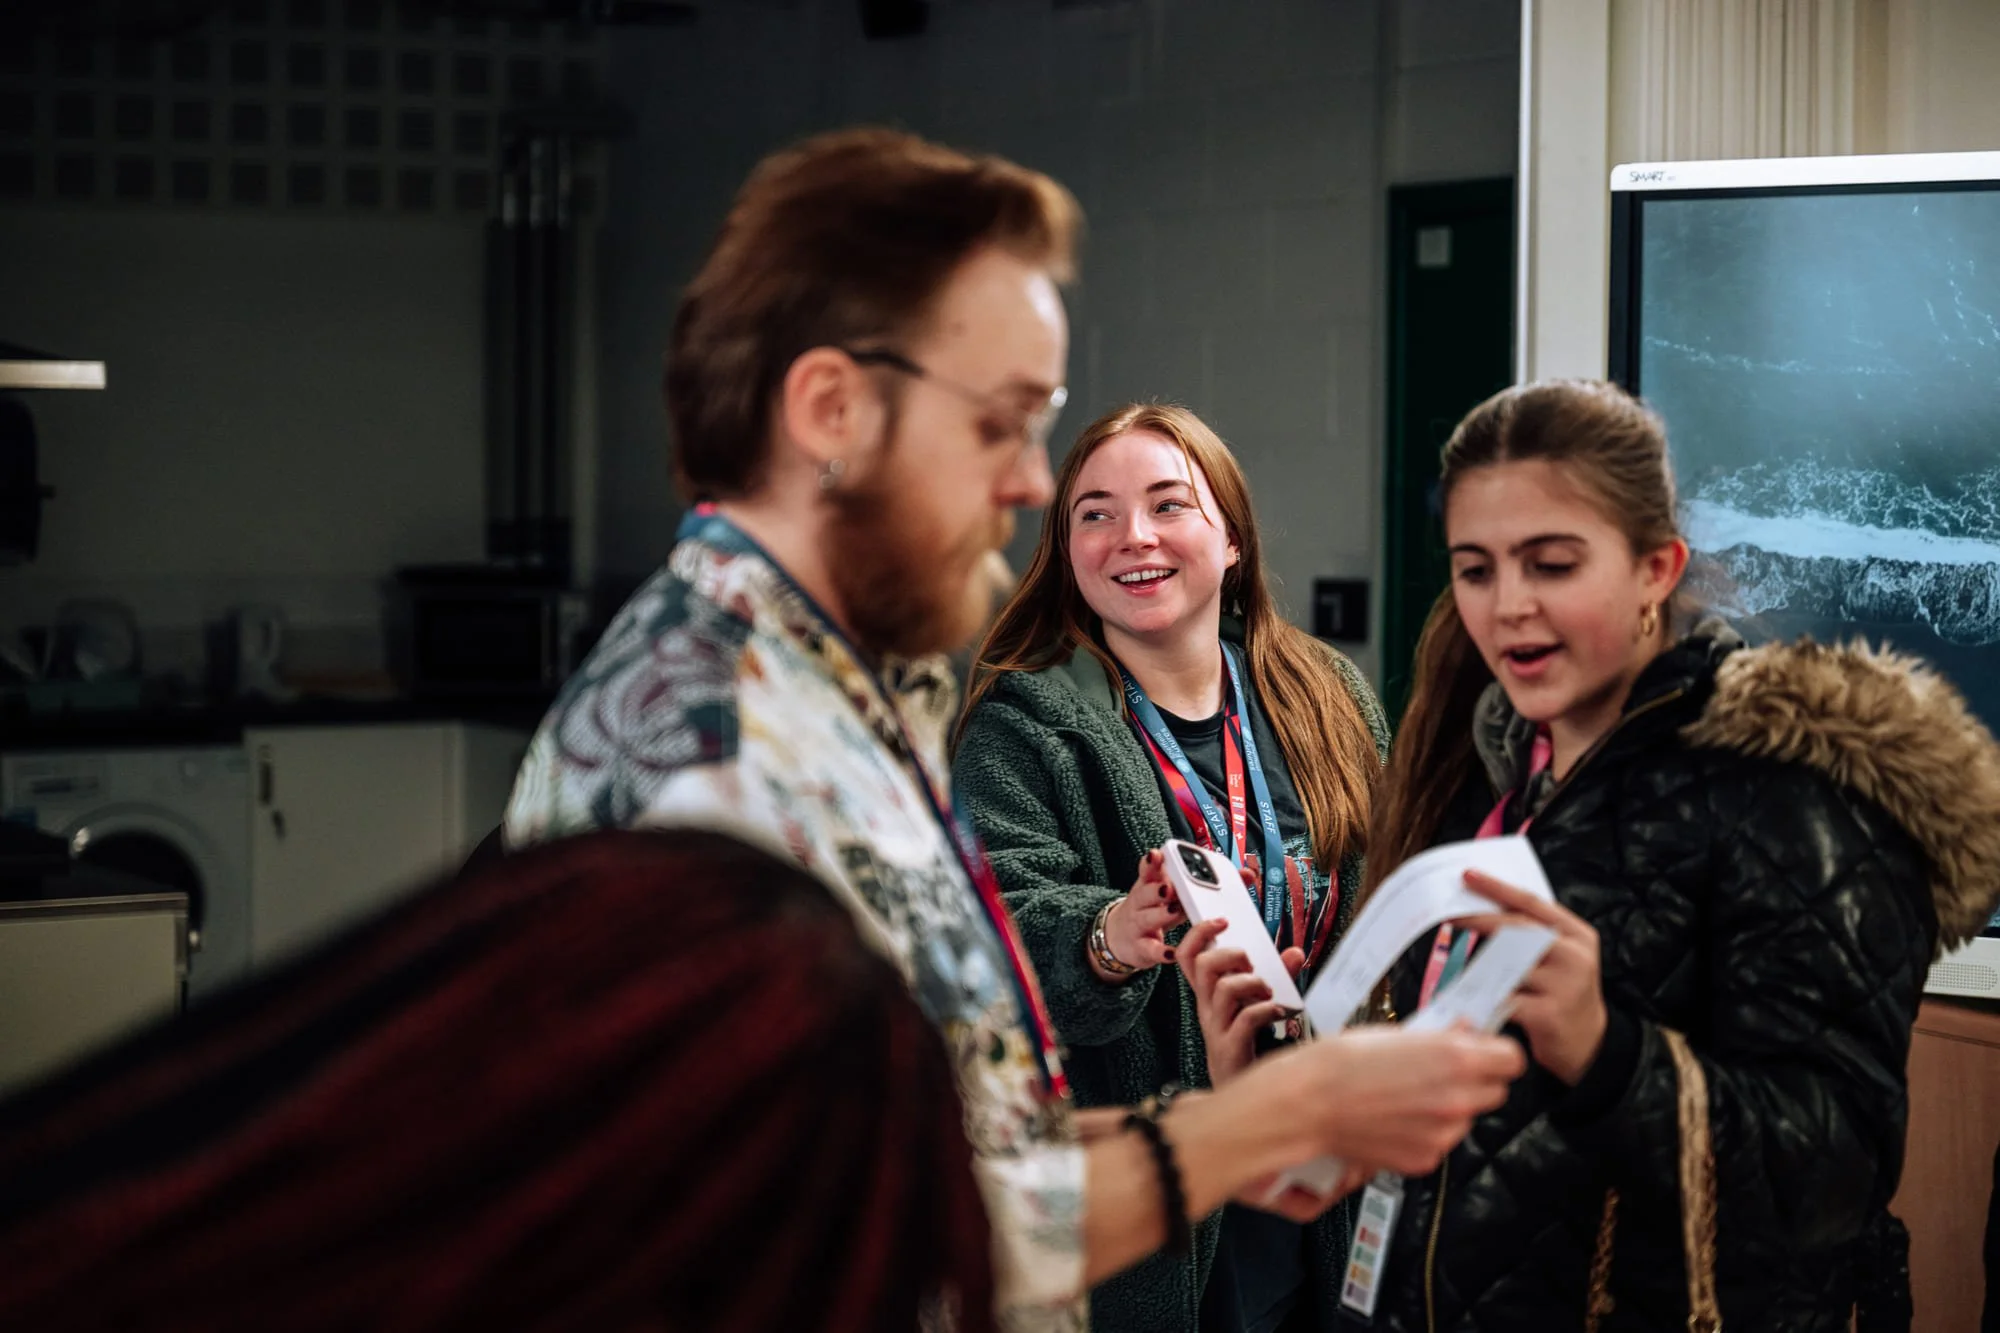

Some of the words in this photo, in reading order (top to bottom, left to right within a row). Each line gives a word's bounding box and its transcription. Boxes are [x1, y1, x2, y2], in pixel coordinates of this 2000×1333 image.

[1202, 803, 1228, 837] STAFF
[1260, 800, 1277, 834] STAFF
[1266, 885, 1275, 922] Futures
[1274, 886, 1282, 920] Sheffield
